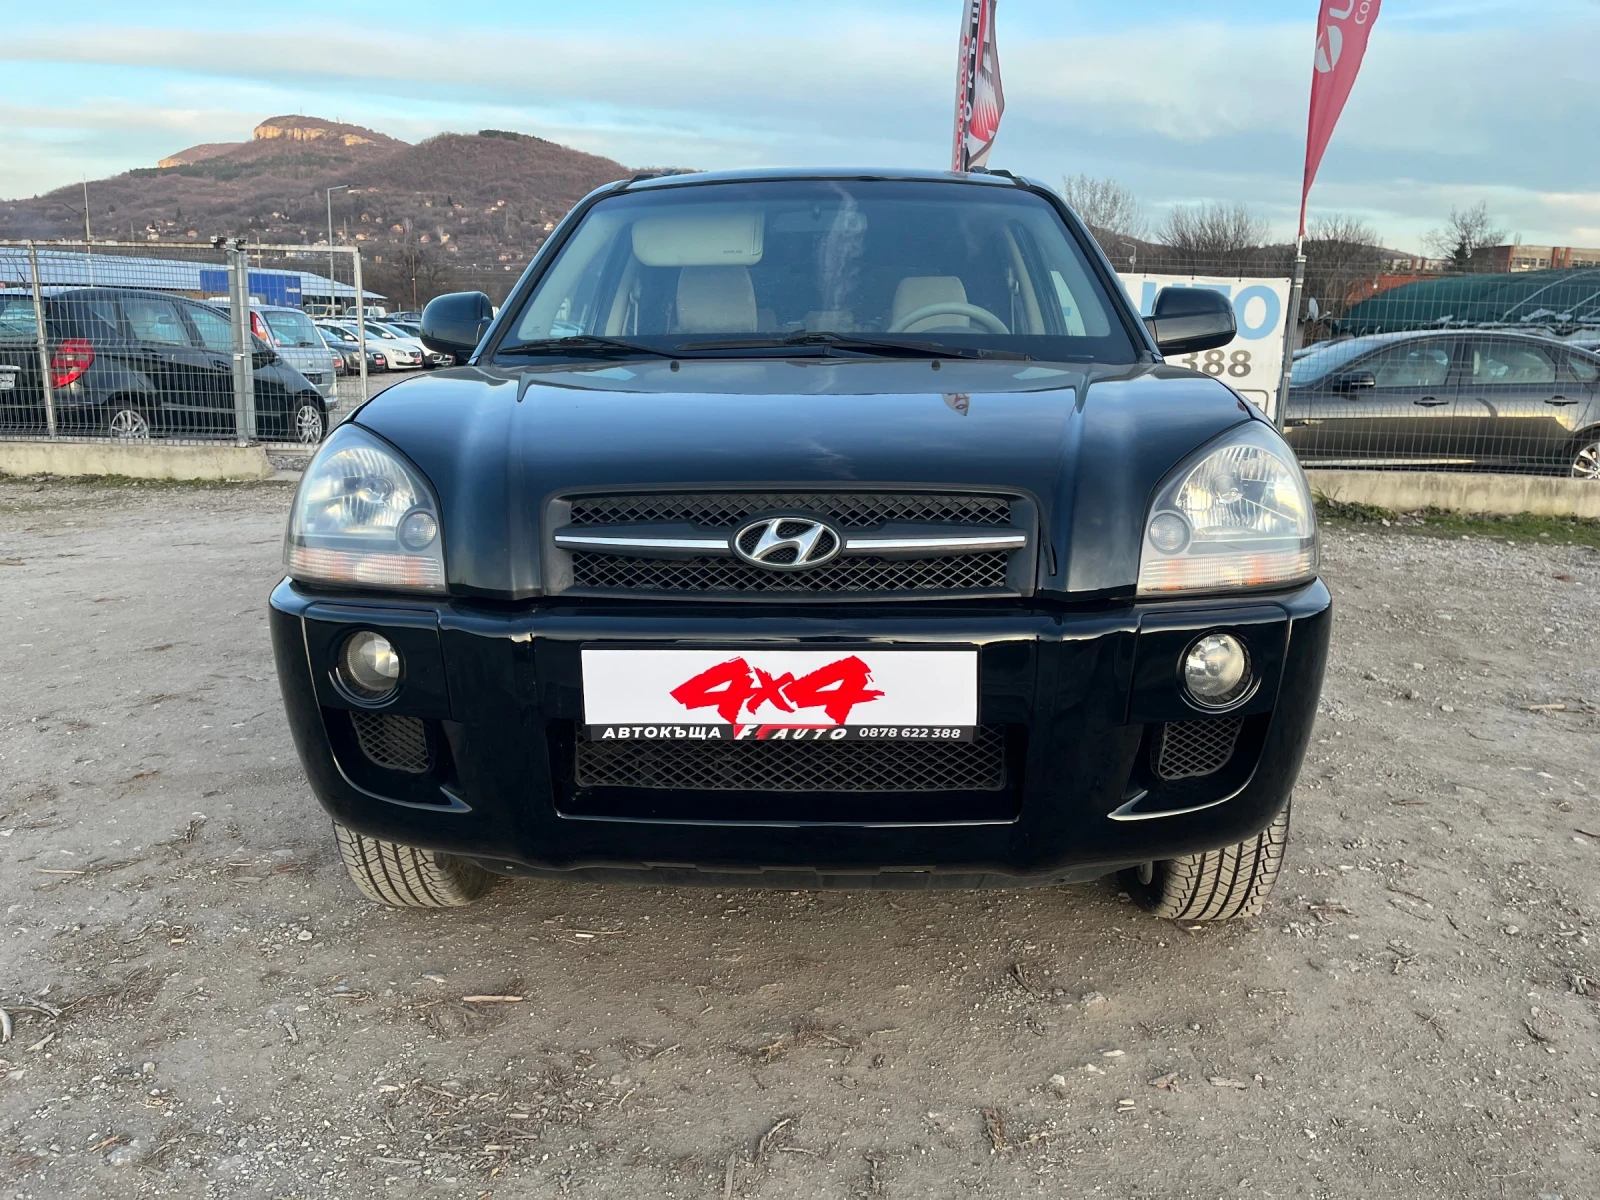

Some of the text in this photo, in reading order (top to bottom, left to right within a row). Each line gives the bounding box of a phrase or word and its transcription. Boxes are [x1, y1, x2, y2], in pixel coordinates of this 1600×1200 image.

[1182, 349, 1252, 378] 388
[602, 726, 722, 740] АВТОКЪЩА
[771, 728, 847, 740] AUTO
[859, 727, 898, 738] 0878
[901, 728, 929, 738] 622
[931, 728, 961, 739] 388
